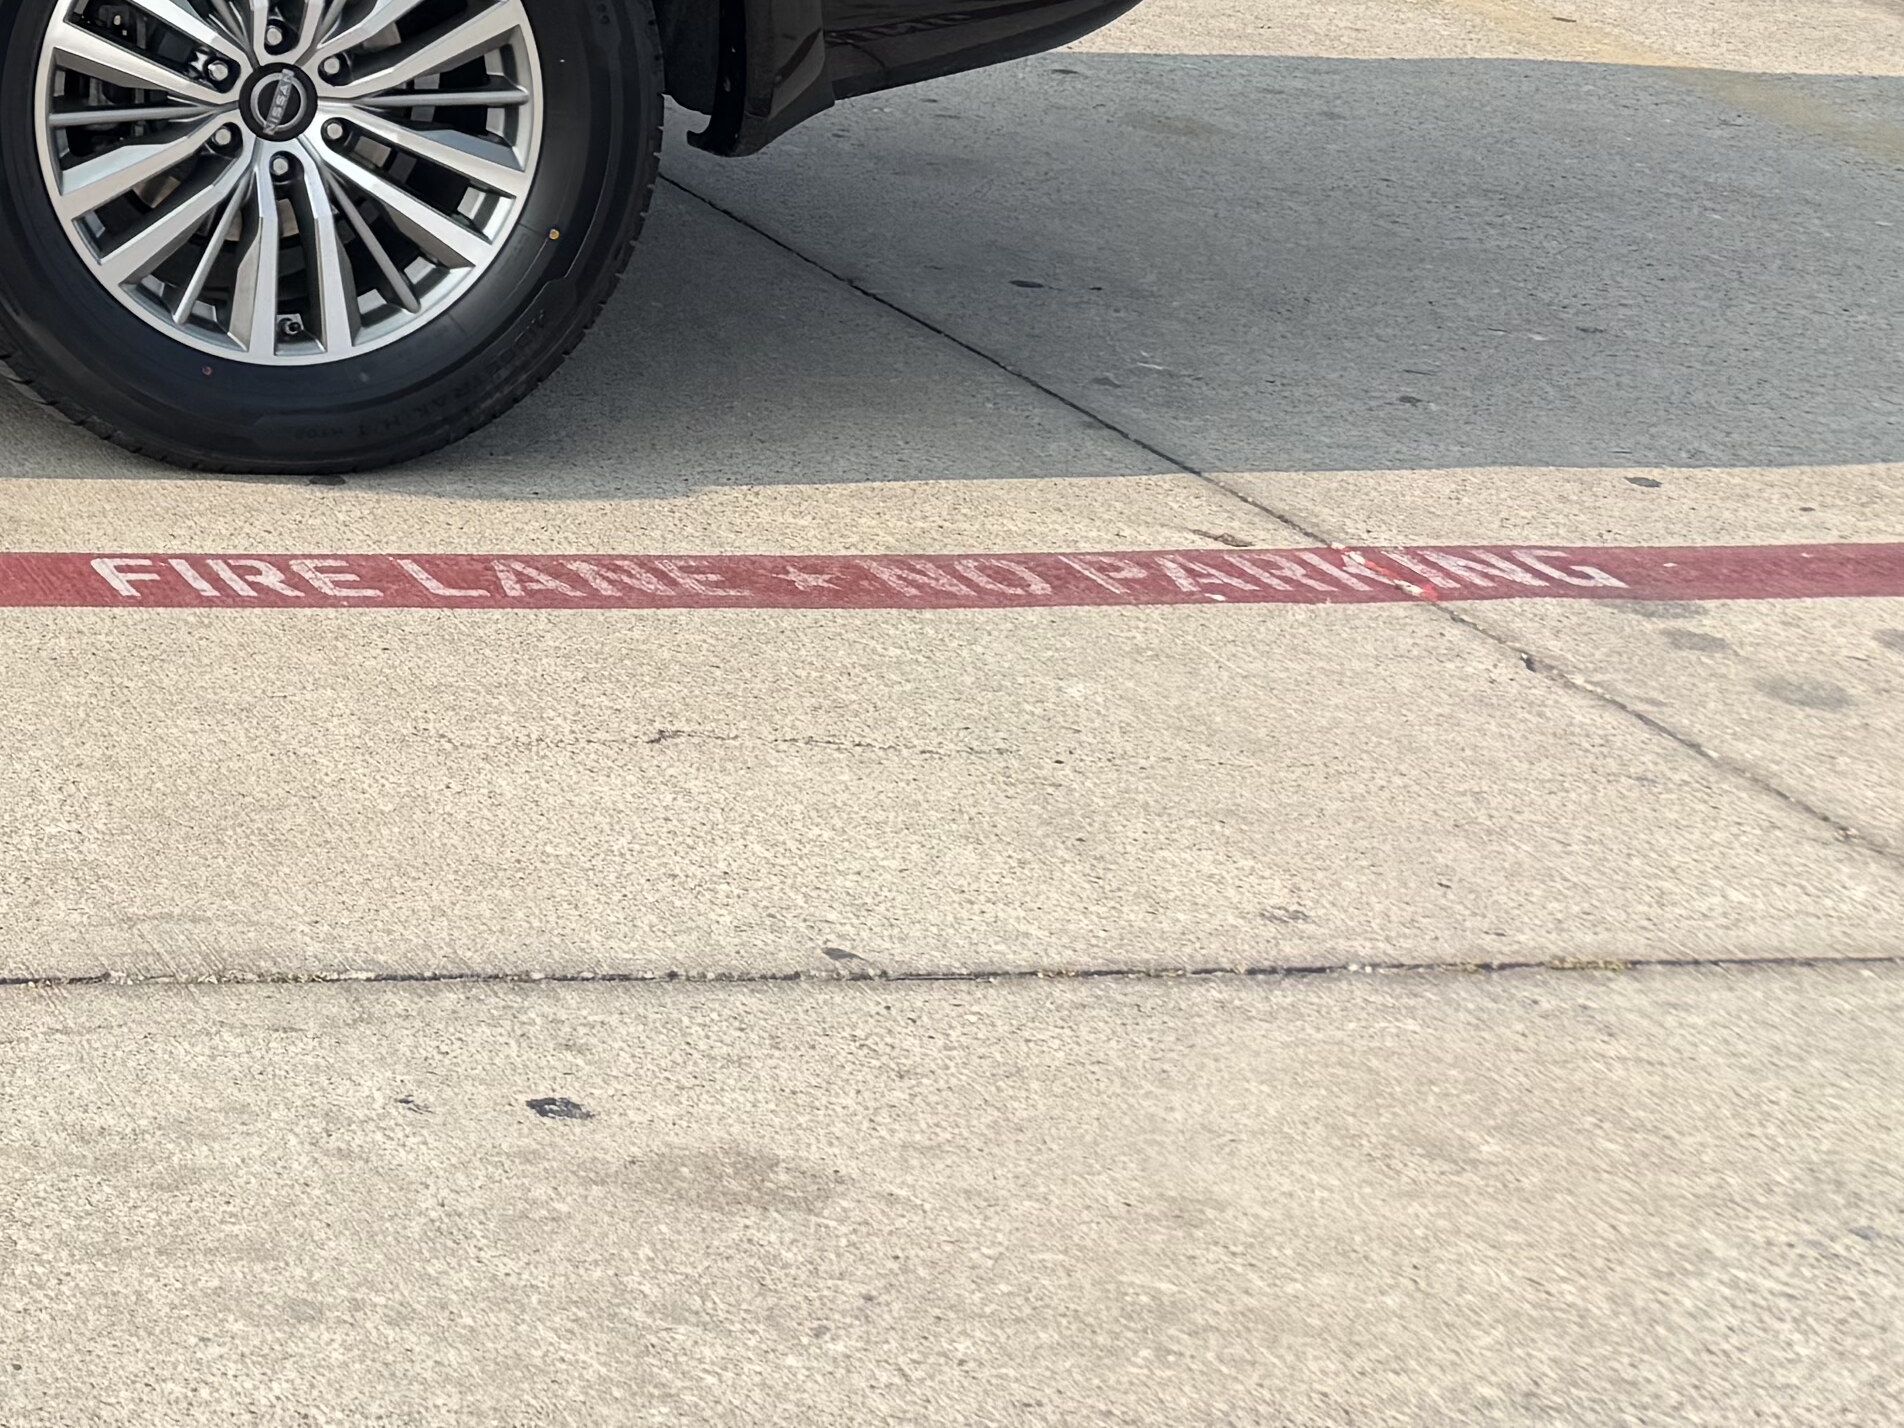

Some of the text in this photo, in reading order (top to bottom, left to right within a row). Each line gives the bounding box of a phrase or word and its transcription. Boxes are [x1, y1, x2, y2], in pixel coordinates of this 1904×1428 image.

[262, 68, 296, 135] NISSAN
[89, 548, 1630, 599] FIRE LANE NO PARKING
